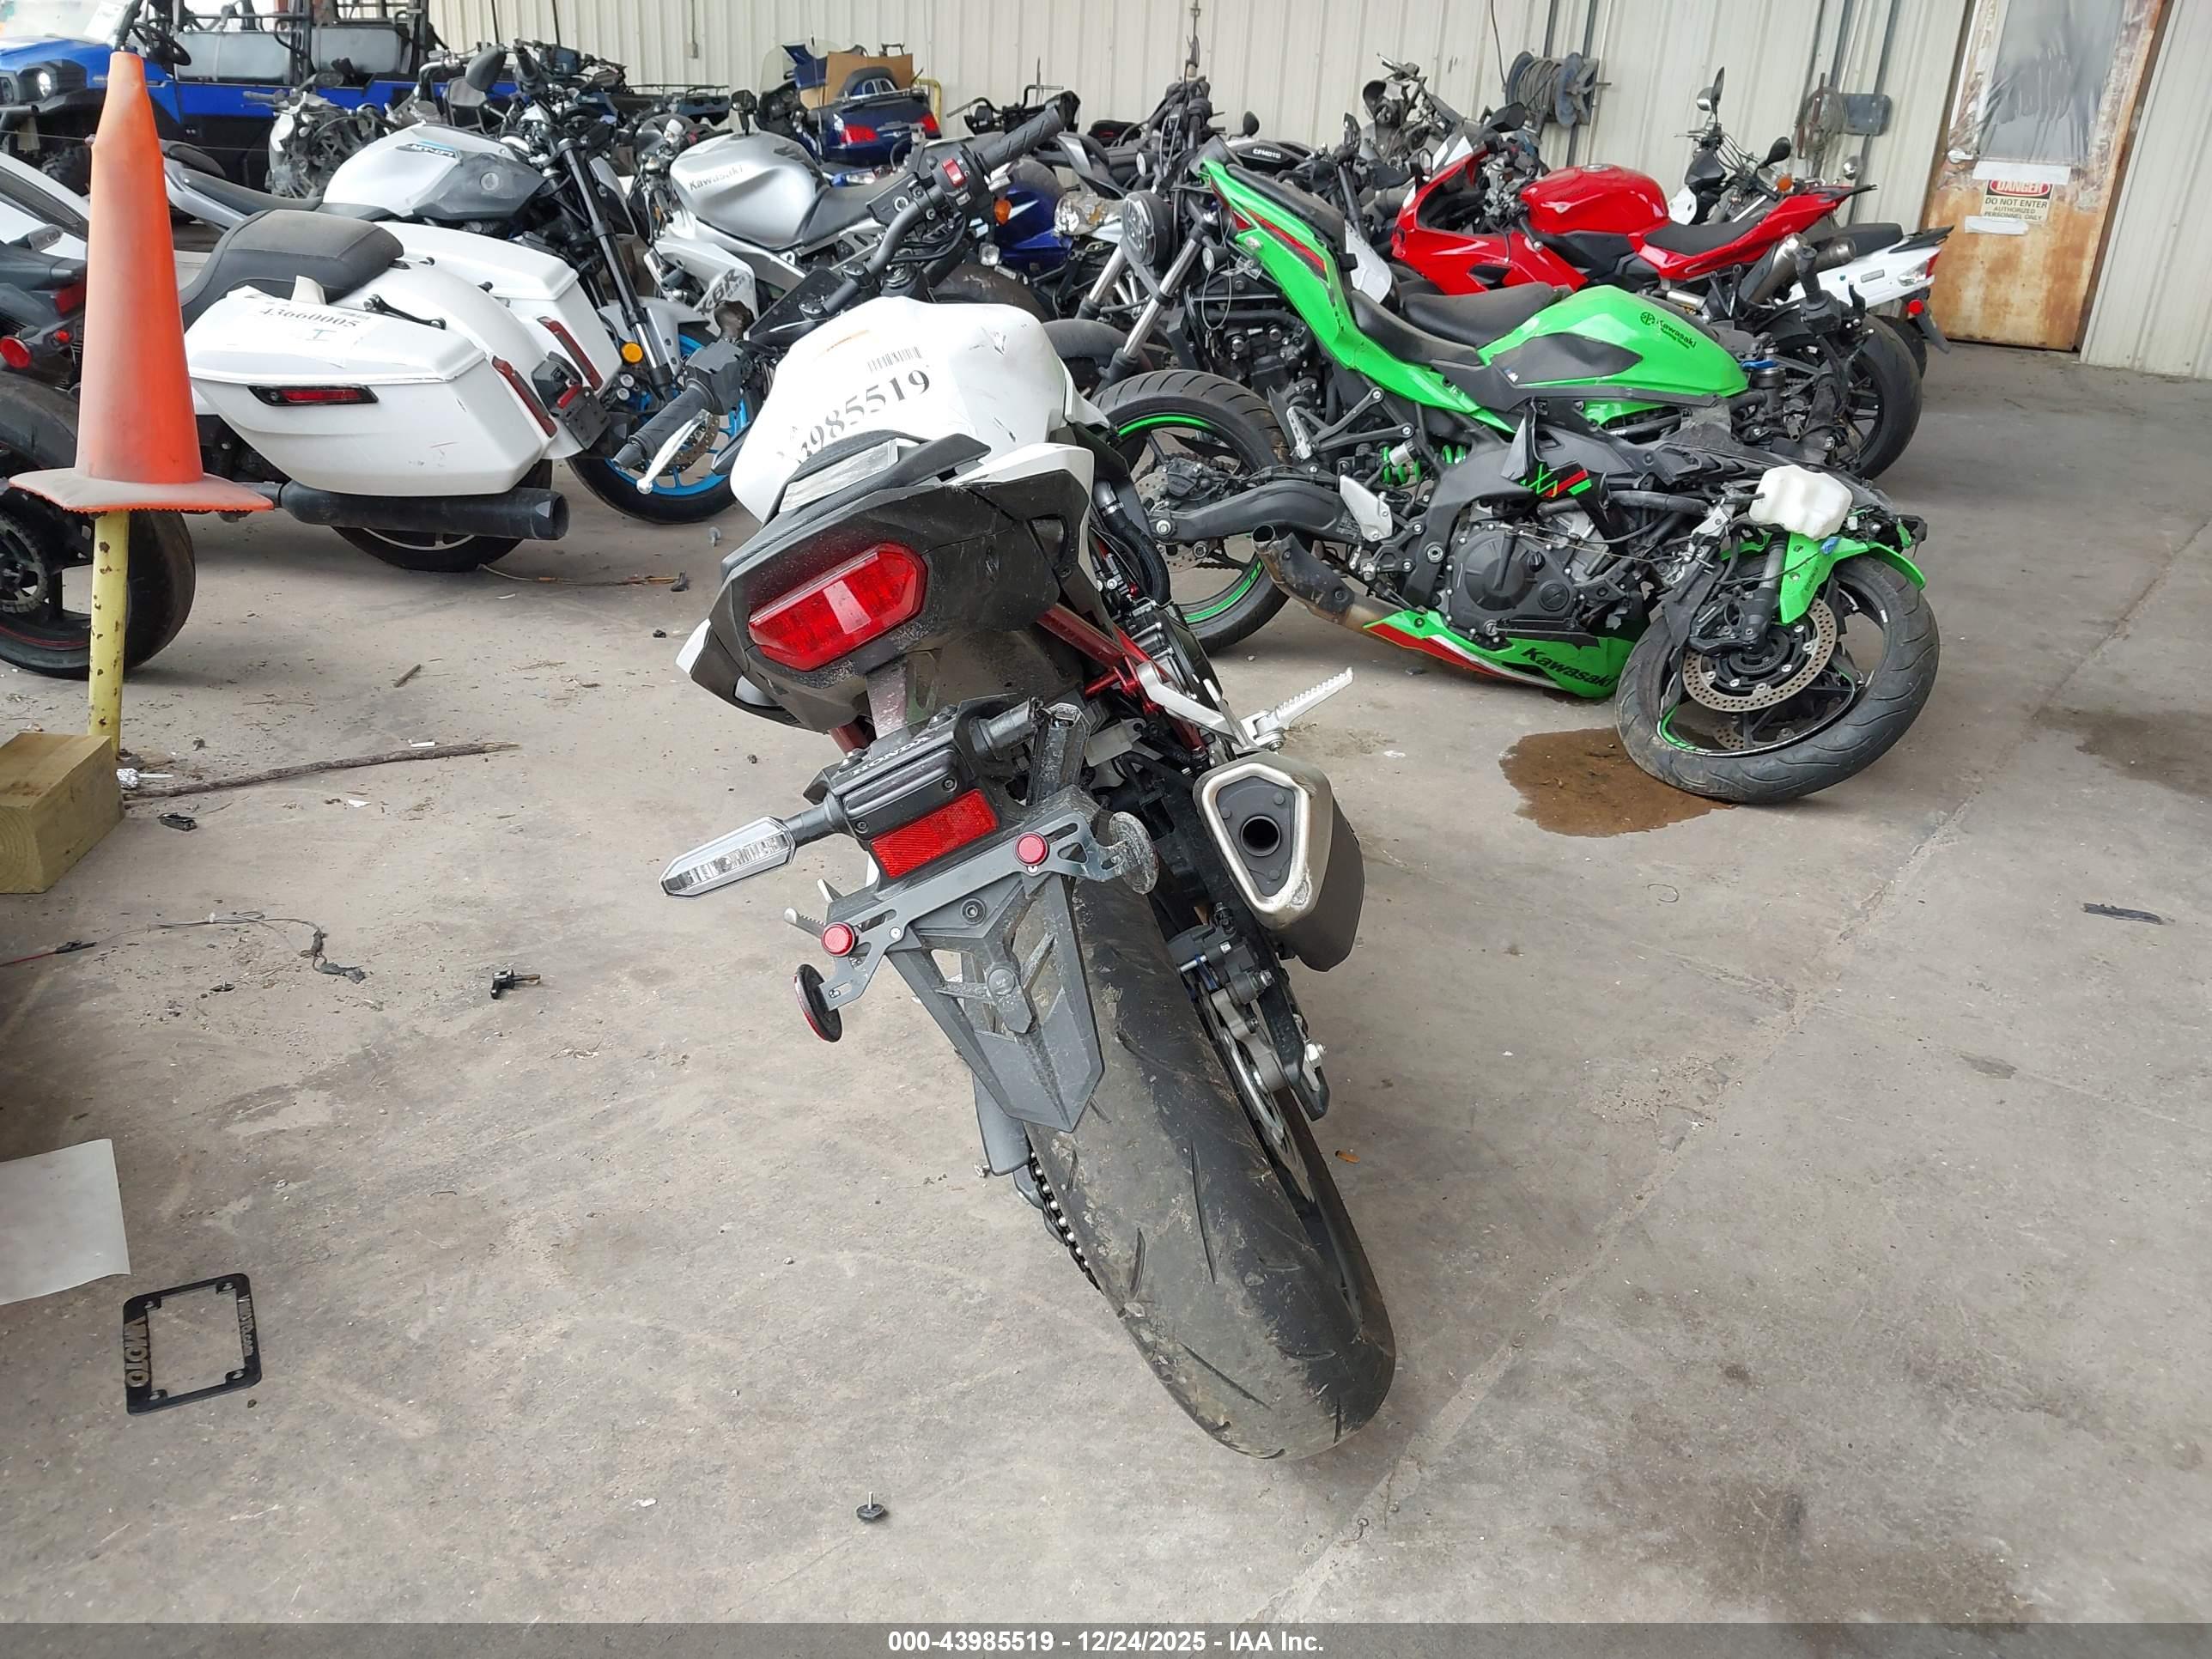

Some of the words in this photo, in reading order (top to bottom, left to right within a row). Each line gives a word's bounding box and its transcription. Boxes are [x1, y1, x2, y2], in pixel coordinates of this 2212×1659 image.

[689, 164, 744, 191] Kawasaki
[1996, 179, 2045, 193] DANGER
[1984, 197, 1995, 205] DO
[1999, 198, 2018, 207] NOT
[2020, 199, 2048, 209] ENTER
[1520, 647, 1618, 688] Kawasaki
[851, 735, 933, 776] HONDA
